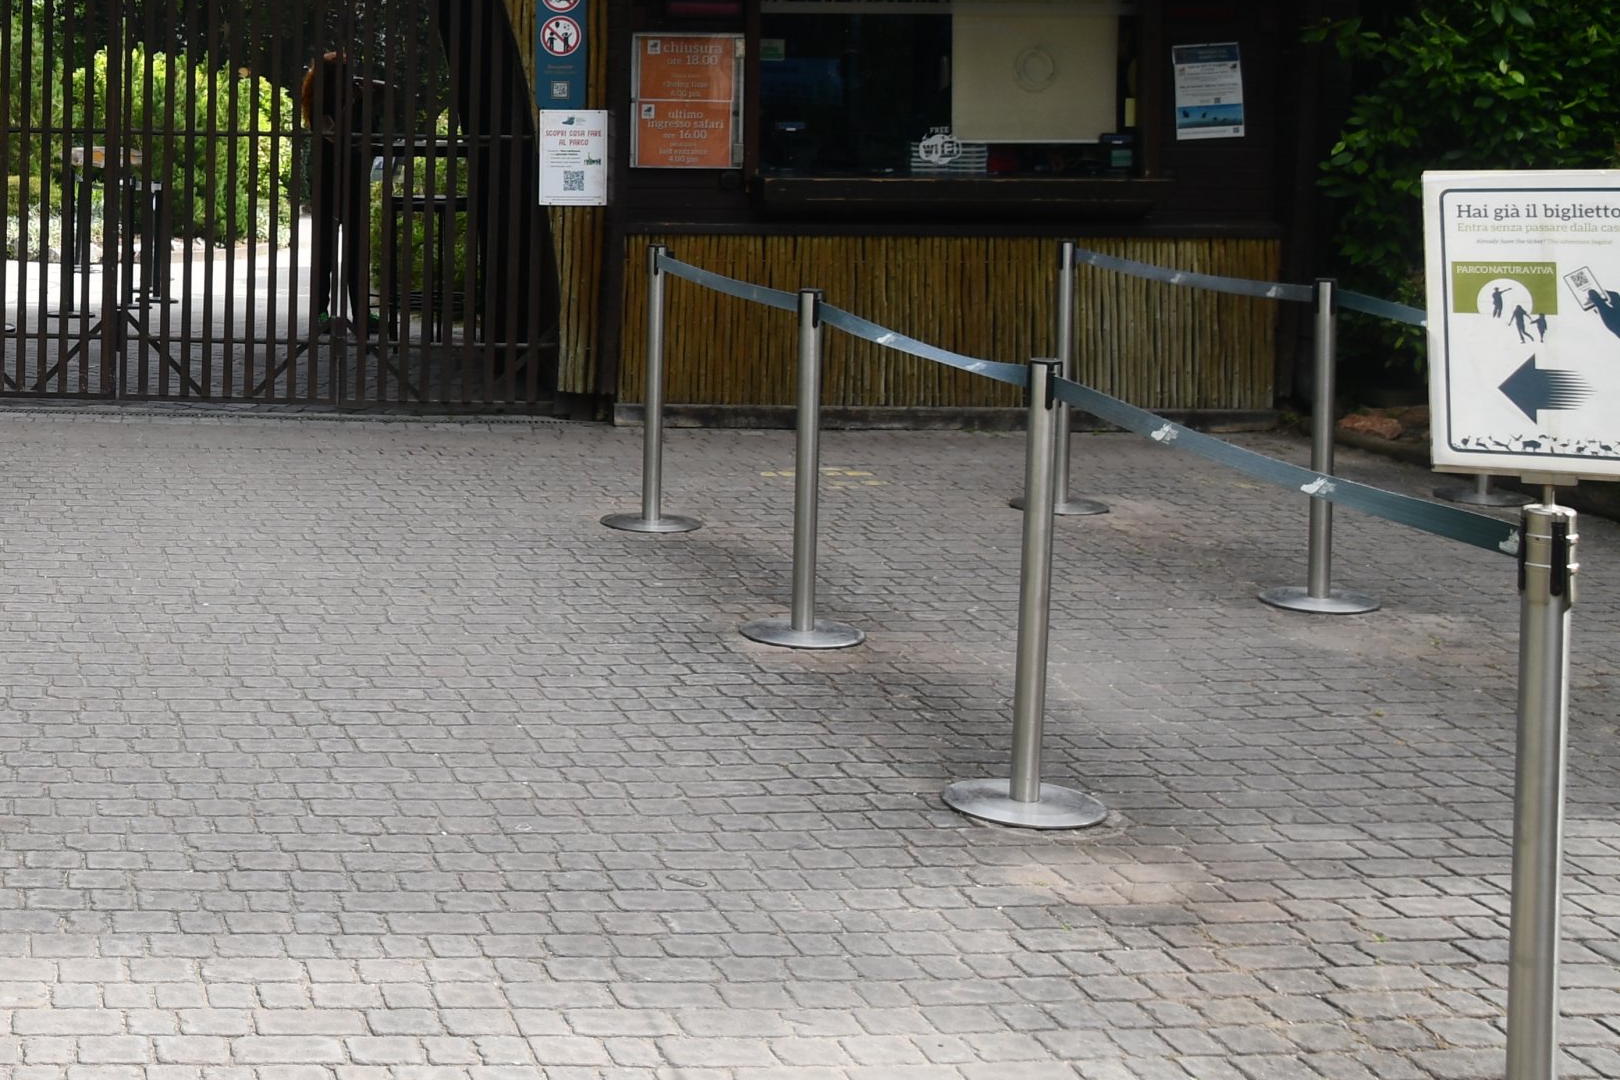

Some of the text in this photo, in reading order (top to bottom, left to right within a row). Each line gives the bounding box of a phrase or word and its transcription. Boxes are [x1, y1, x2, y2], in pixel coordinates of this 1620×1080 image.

[663, 41, 723, 54] chiusura
[686, 54, 718, 65] 18.00
[668, 109, 703, 119] ultimo
[647, 119, 724, 130] ingresso safari
[930, 126, 949, 134] FREE
[679, 129, 708, 139] 16.00
[1456, 203, 1620, 222] Hai già il biglietto
[1457, 223, 1488, 232] Entra
[1489, 224, 1522, 232] senza
[1526, 224, 1567, 235] passare
[1570, 222, 1598, 232] dalla
